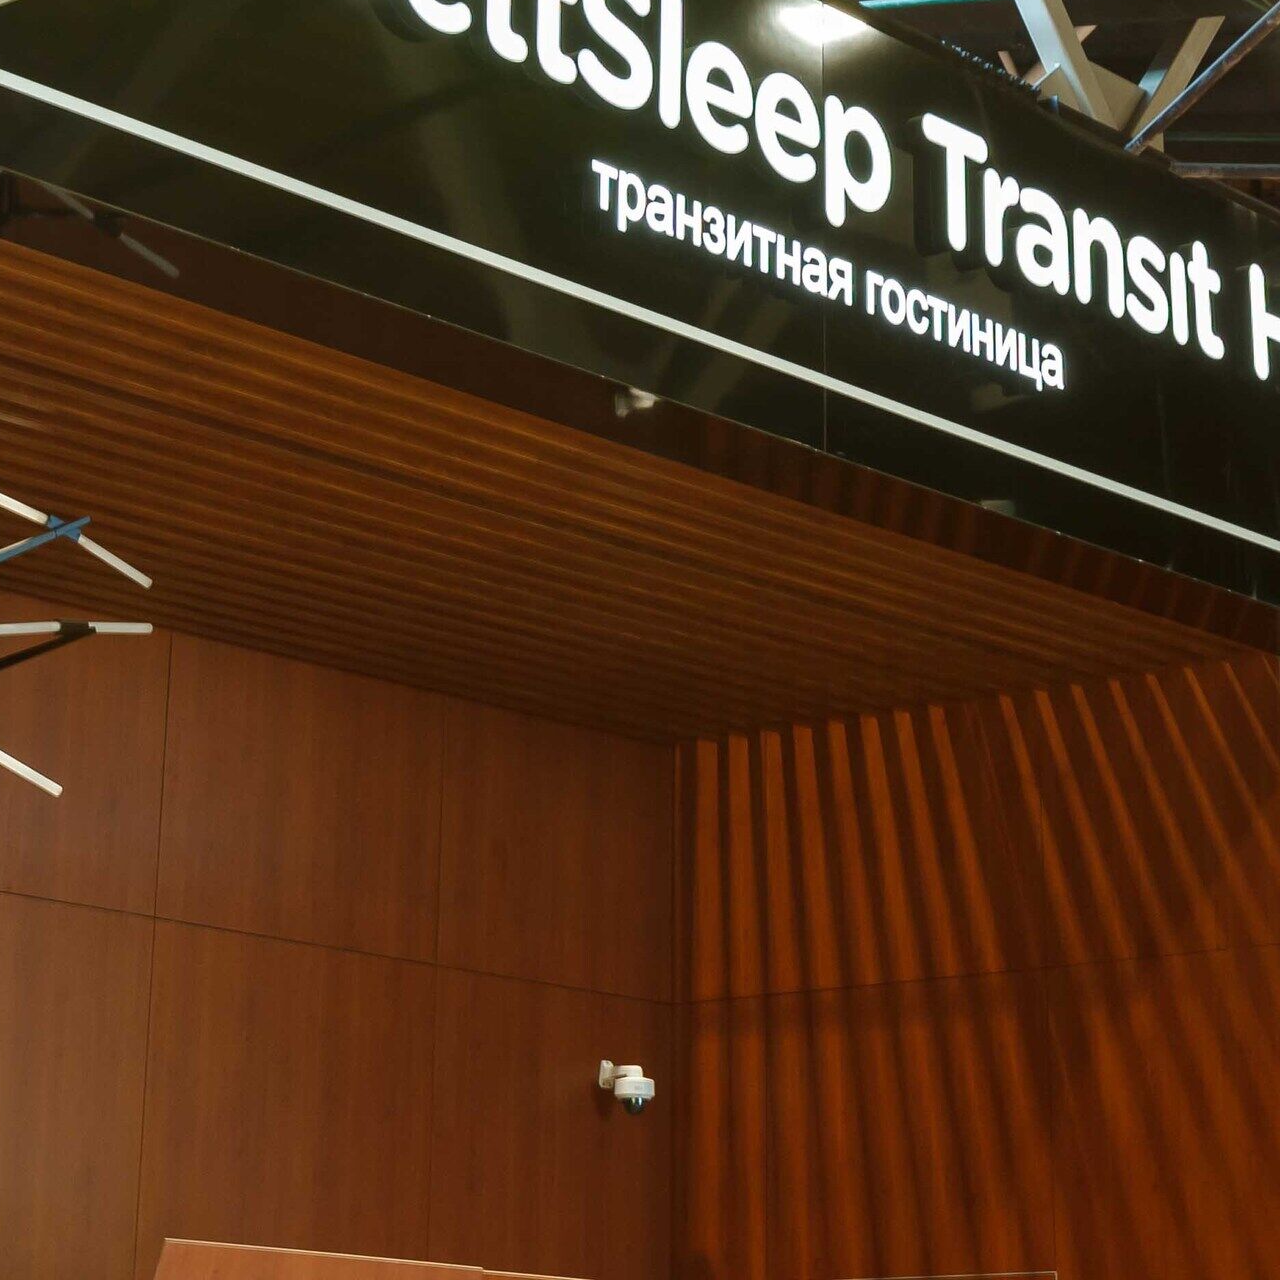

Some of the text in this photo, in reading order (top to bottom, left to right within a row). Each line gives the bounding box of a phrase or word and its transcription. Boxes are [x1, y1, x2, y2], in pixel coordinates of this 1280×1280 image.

[591, 158, 1067, 393] транзитная гостиница
[921, 113, 1224, 360] Transit
